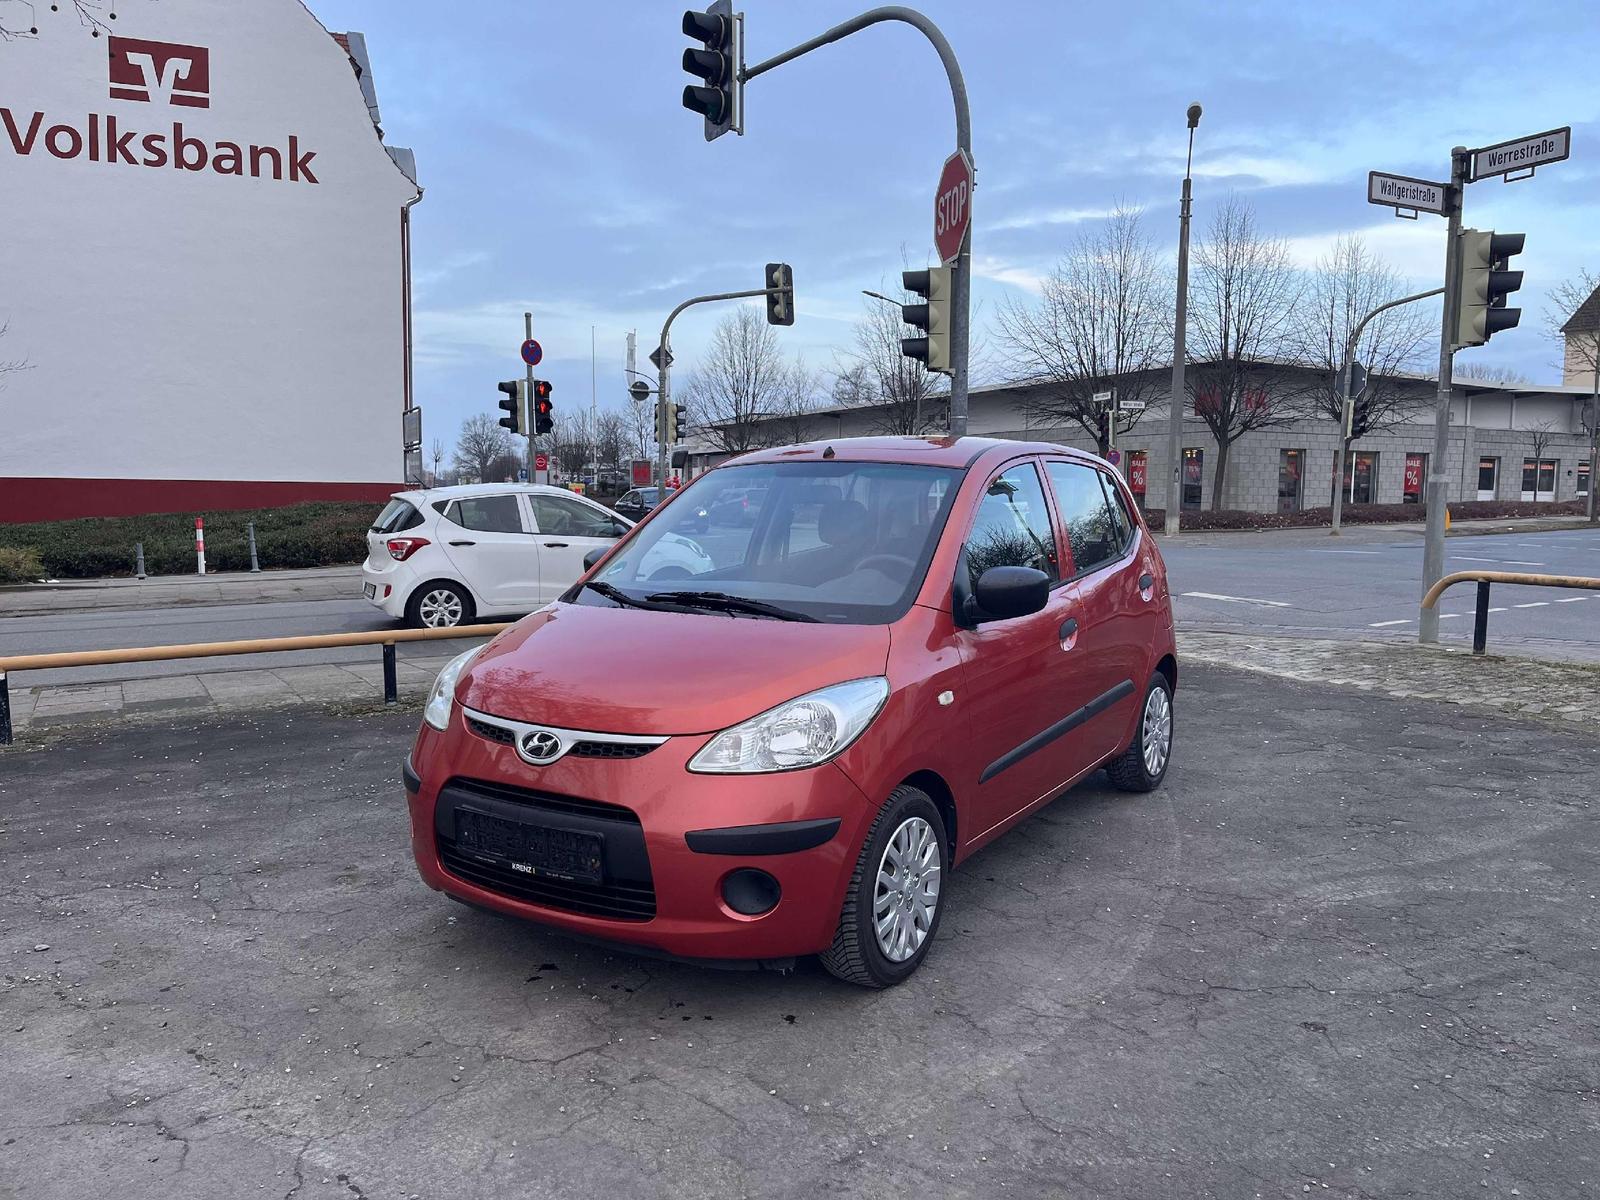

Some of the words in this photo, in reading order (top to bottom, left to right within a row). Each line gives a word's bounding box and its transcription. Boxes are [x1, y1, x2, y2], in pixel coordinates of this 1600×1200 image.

[0, 107, 320, 184] Volksbank
[1488, 139, 1554, 167] Werrestraße
[937, 180, 967, 236] STOP
[1132, 470, 1144, 485] %
[1407, 470, 1418, 486] %
[511, 862, 533, 874] KRENZ
